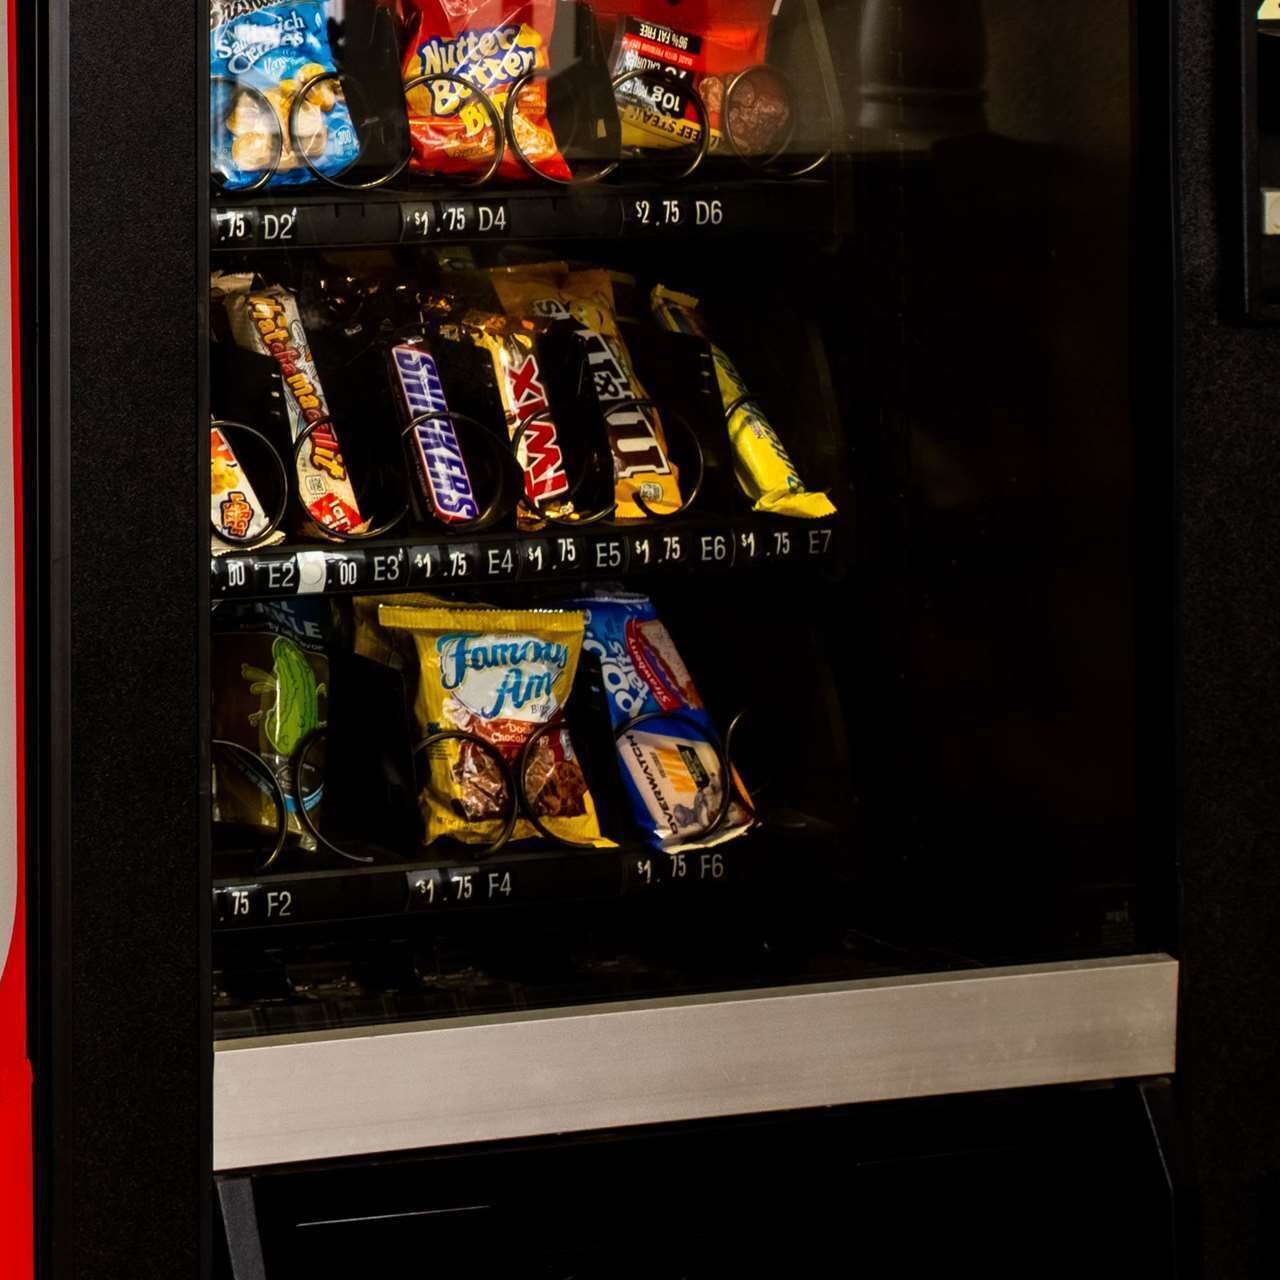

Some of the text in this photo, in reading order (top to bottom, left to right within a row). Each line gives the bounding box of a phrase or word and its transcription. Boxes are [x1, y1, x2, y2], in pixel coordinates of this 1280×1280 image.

[422, 28, 517, 75] Nutter
[264, 213, 293, 240] D2
[478, 206, 507, 232] D4
[696, 202, 723, 226] D6
[395, 347, 478, 522] SNICKERS
[596, 542, 621, 567] E5
[701, 536, 726, 560] E6
[808, 530, 832, 554] E7
[373, 556, 400, 581] E3
[488, 549, 513, 574] E4
[268, 563, 295, 588] E2
[437, 633, 568, 689] Famous
[700, 856, 724, 880] F6
[488, 873, 512, 897] F4
[266, 892, 293, 918] F2
